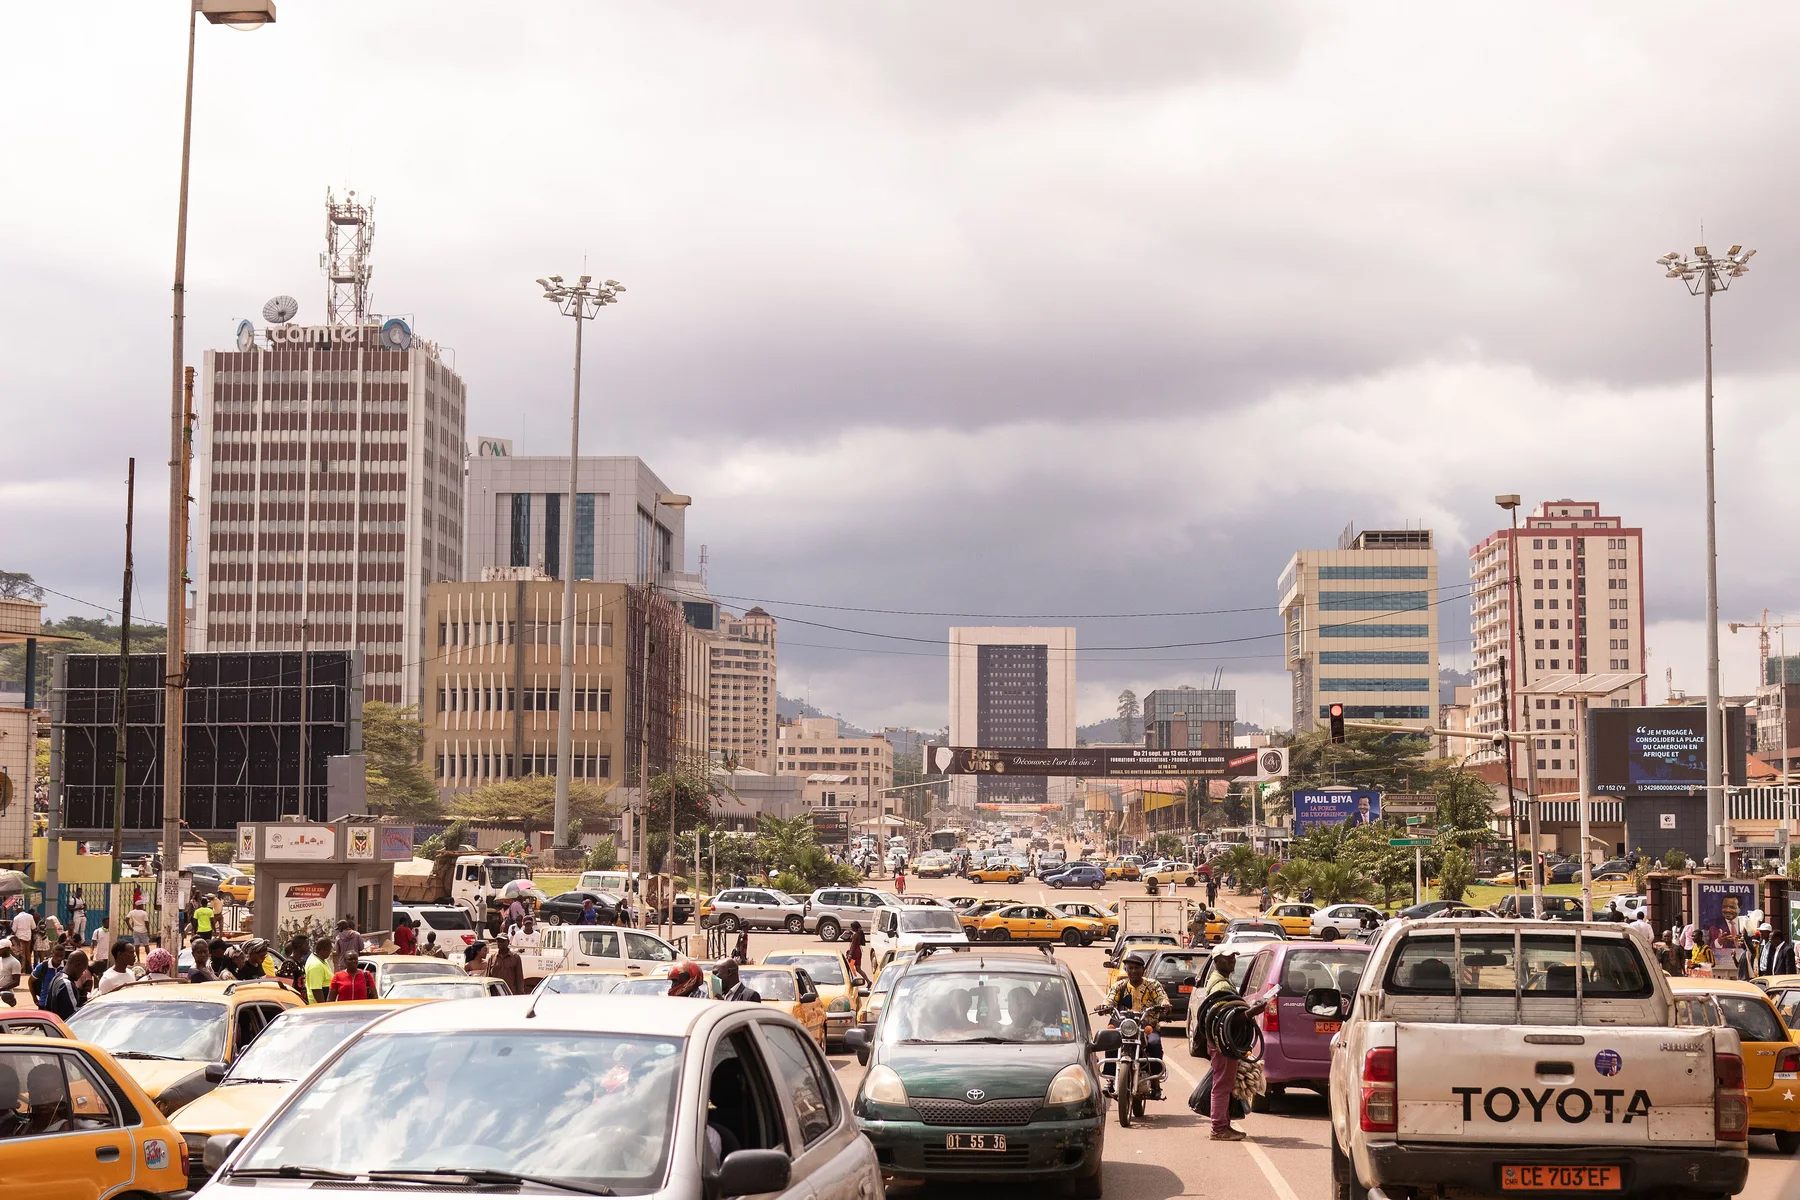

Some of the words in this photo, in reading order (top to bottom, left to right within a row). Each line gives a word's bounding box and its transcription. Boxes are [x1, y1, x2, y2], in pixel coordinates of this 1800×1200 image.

[272, 320, 364, 343] camtel
[971, 750, 1000, 760] FOIRE
[968, 761, 990, 771] VINS
[1012, 756, 1050, 765] Découvrez
[1052, 757, 1068, 766] l'art
[1068, 758, 1077, 766] du
[290, 901, 322, 909] CAMEROUNAIS
[1324, 1023, 1335, 1031] CE
[1660, 1042, 1704, 1052] HILUX
[1452, 1087, 1653, 1124] TOYOTA
[948, 1134, 959, 1148] 01
[970, 1135, 984, 1148] 55
[994, 1136, 1005, 1149] 36
[1521, 1167, 1544, 1186] CE
[1548, 1167, 1586, 1186] 703
[1588, 1167, 1610, 1186] EF
